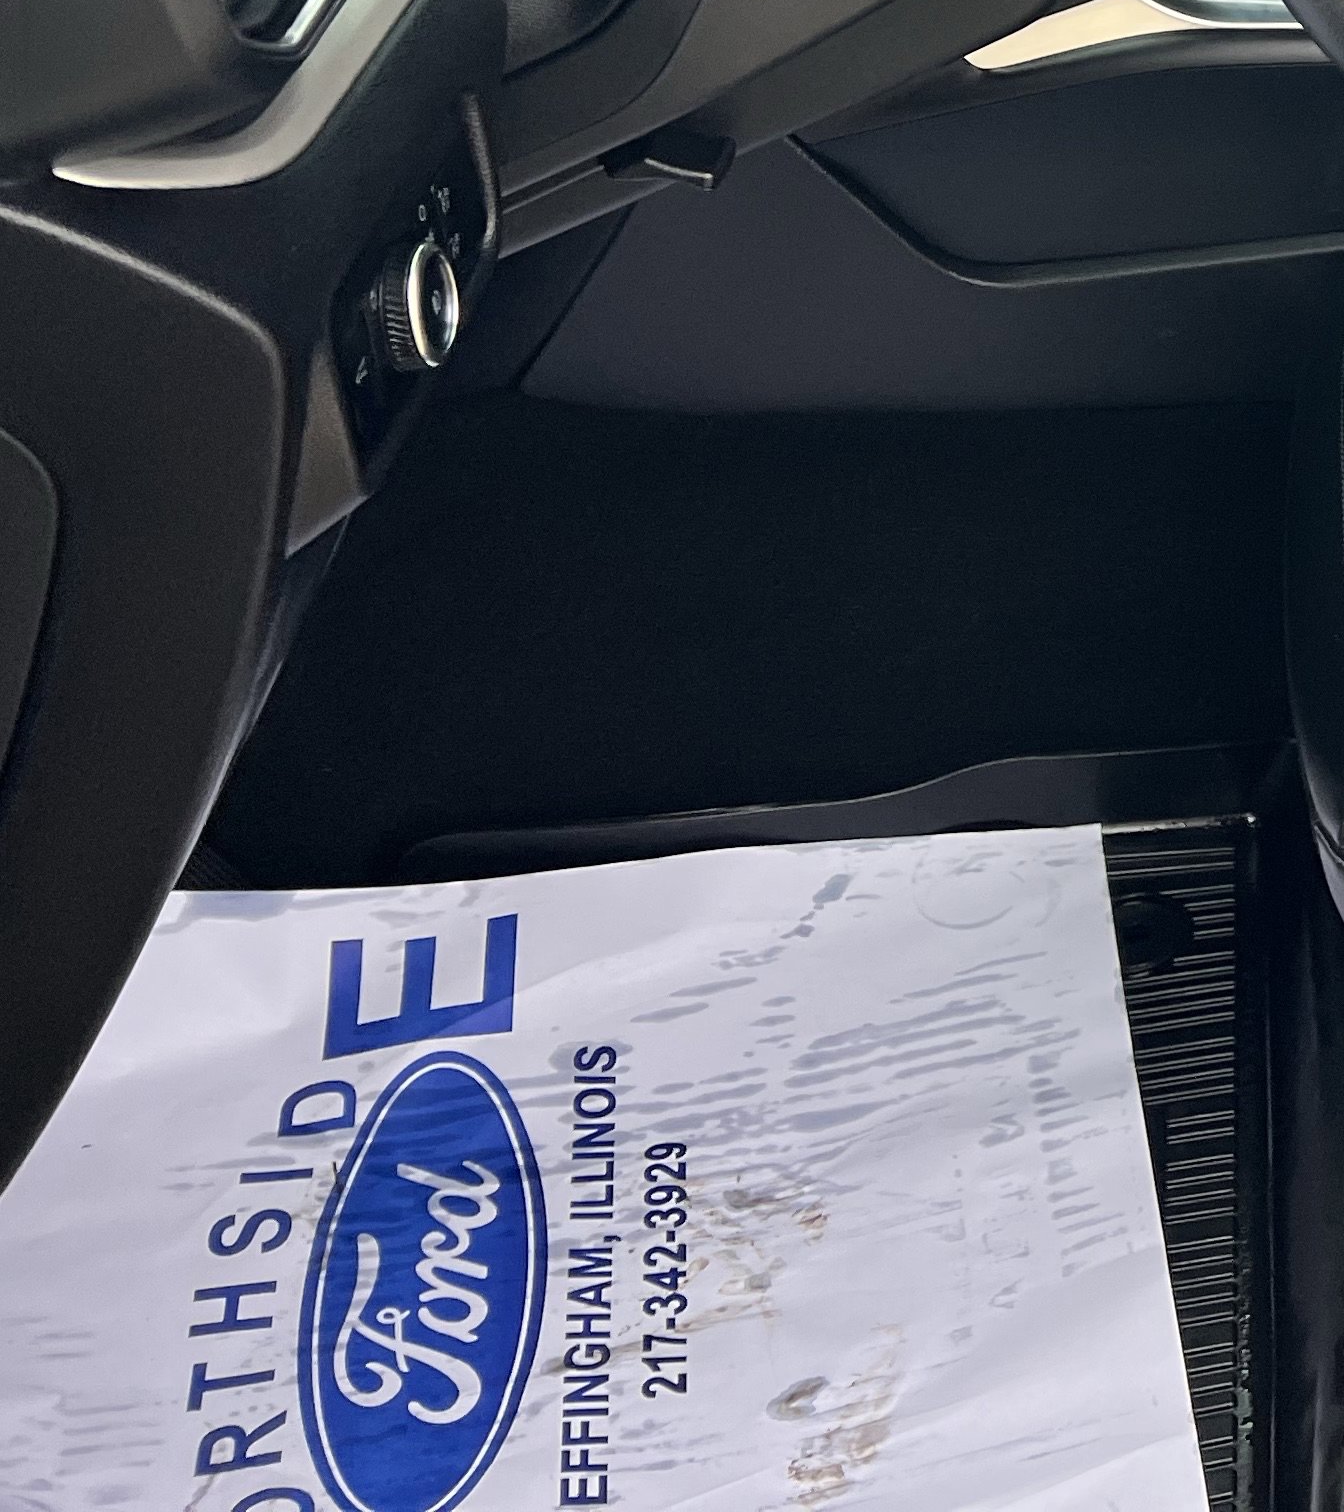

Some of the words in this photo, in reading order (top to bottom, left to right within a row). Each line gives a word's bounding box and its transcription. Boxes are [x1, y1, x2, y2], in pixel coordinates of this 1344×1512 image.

[569, 1045, 617, 1220] ILLINOIS
[334, 1160, 501, 1425] Ford
[559, 1235, 622, 1507] EFFINGHAM,
[641, 1142, 688, 1399] 217-342-3929
